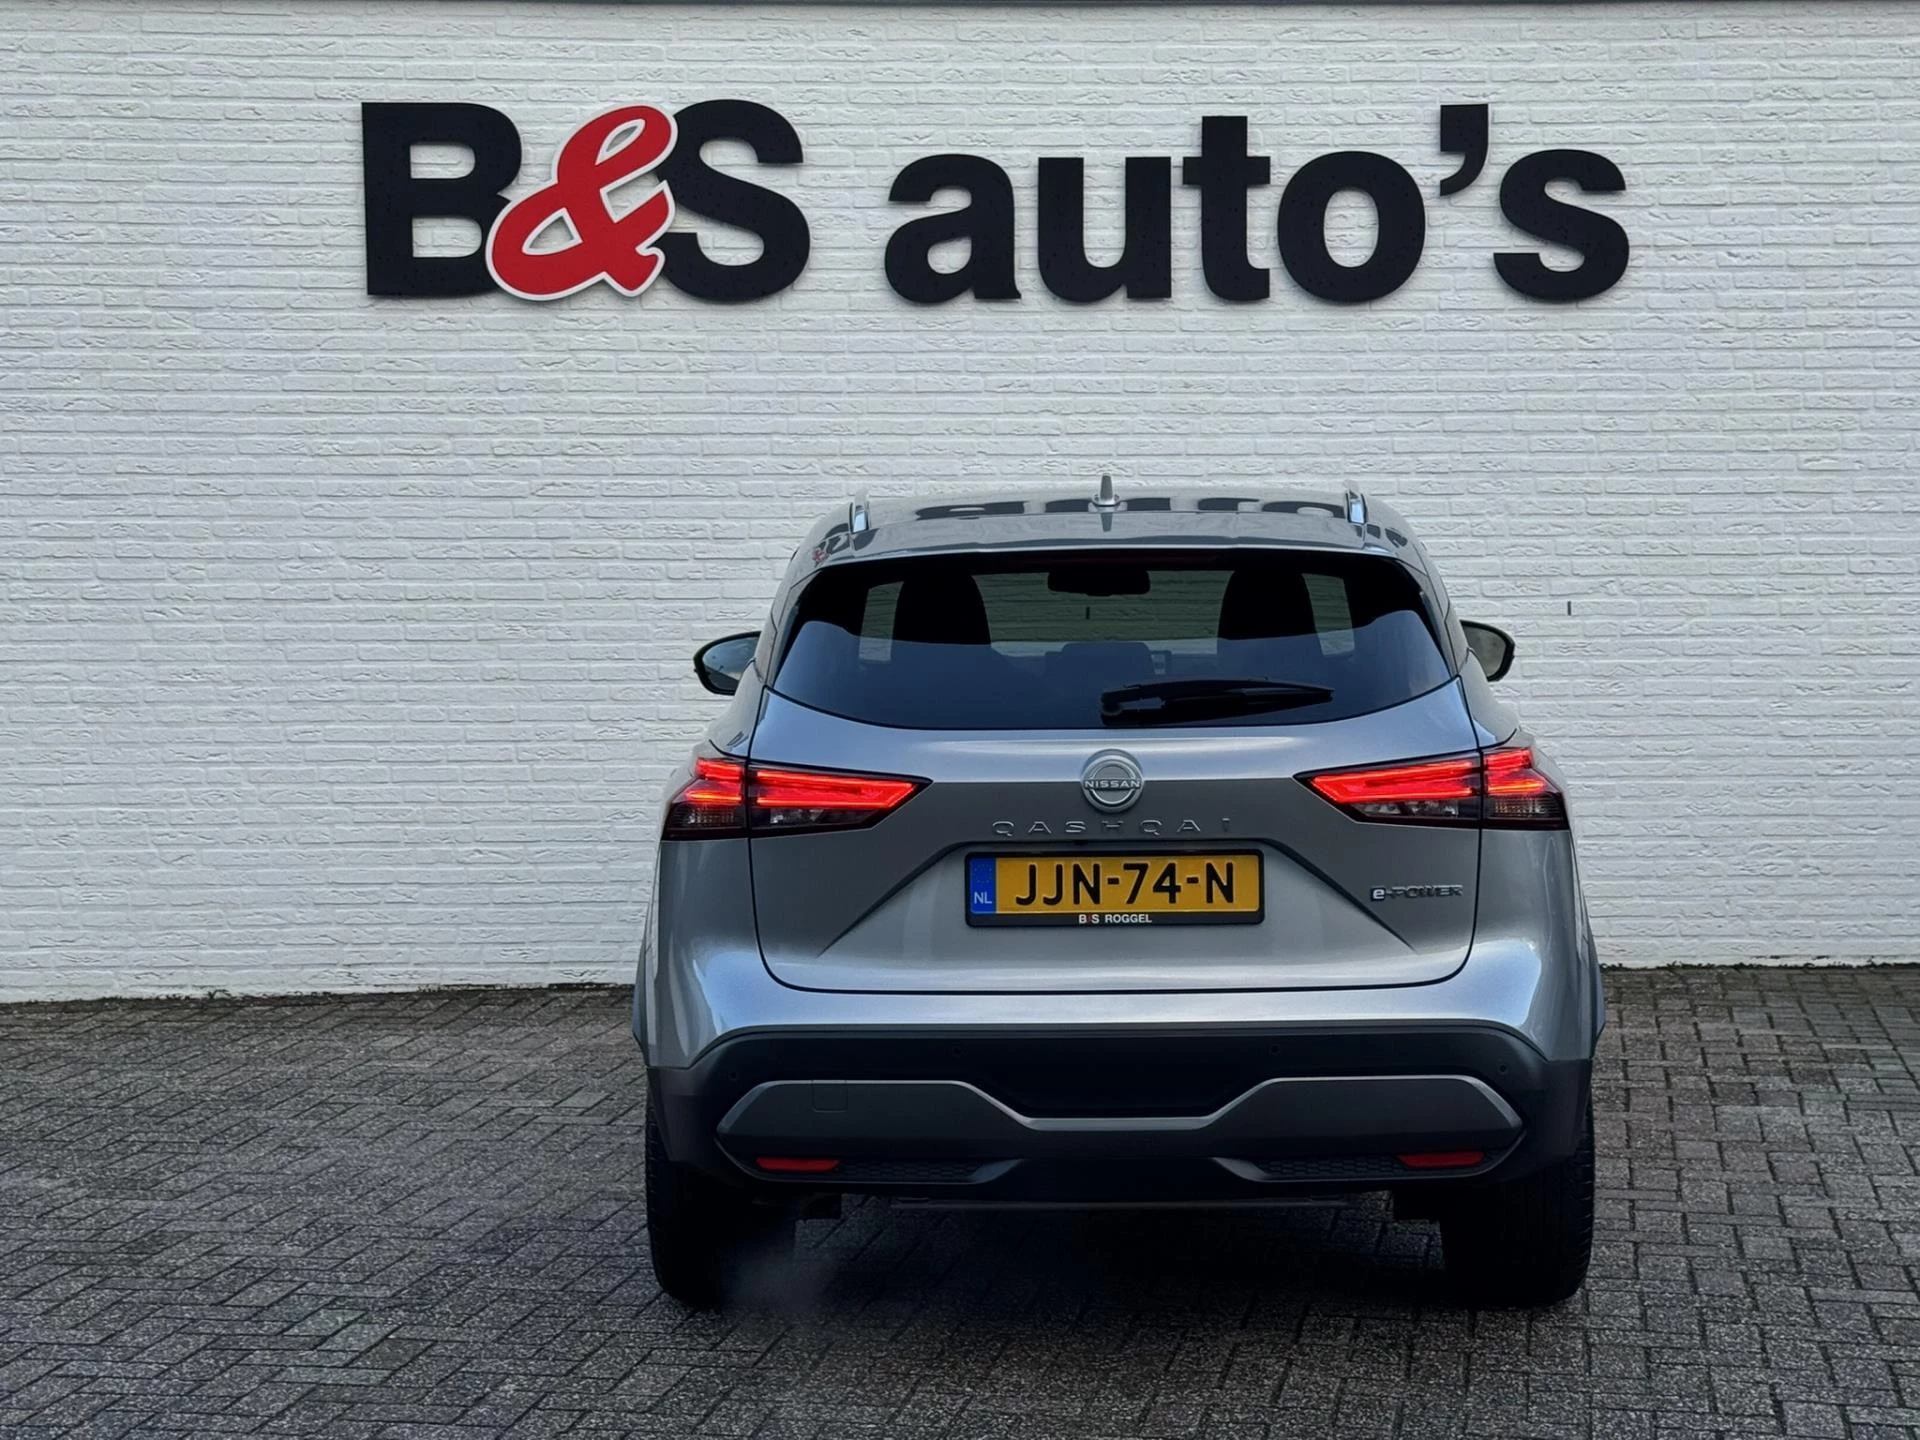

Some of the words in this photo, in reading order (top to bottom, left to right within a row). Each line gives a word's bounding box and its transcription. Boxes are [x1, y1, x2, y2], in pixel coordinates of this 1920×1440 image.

[361, 98, 811, 301] B&S
[884, 102, 1630, 304] auto's
[1084, 779, 1141, 789] NISSAN
[992, 817, 1232, 837] QASHQAI
[974, 892, 992, 904] NL
[1015, 862, 1235, 905] JJN-74-N
[1371, 884, 1463, 900] e-POWER
[1105, 913, 1152, 923] ROGGEL
